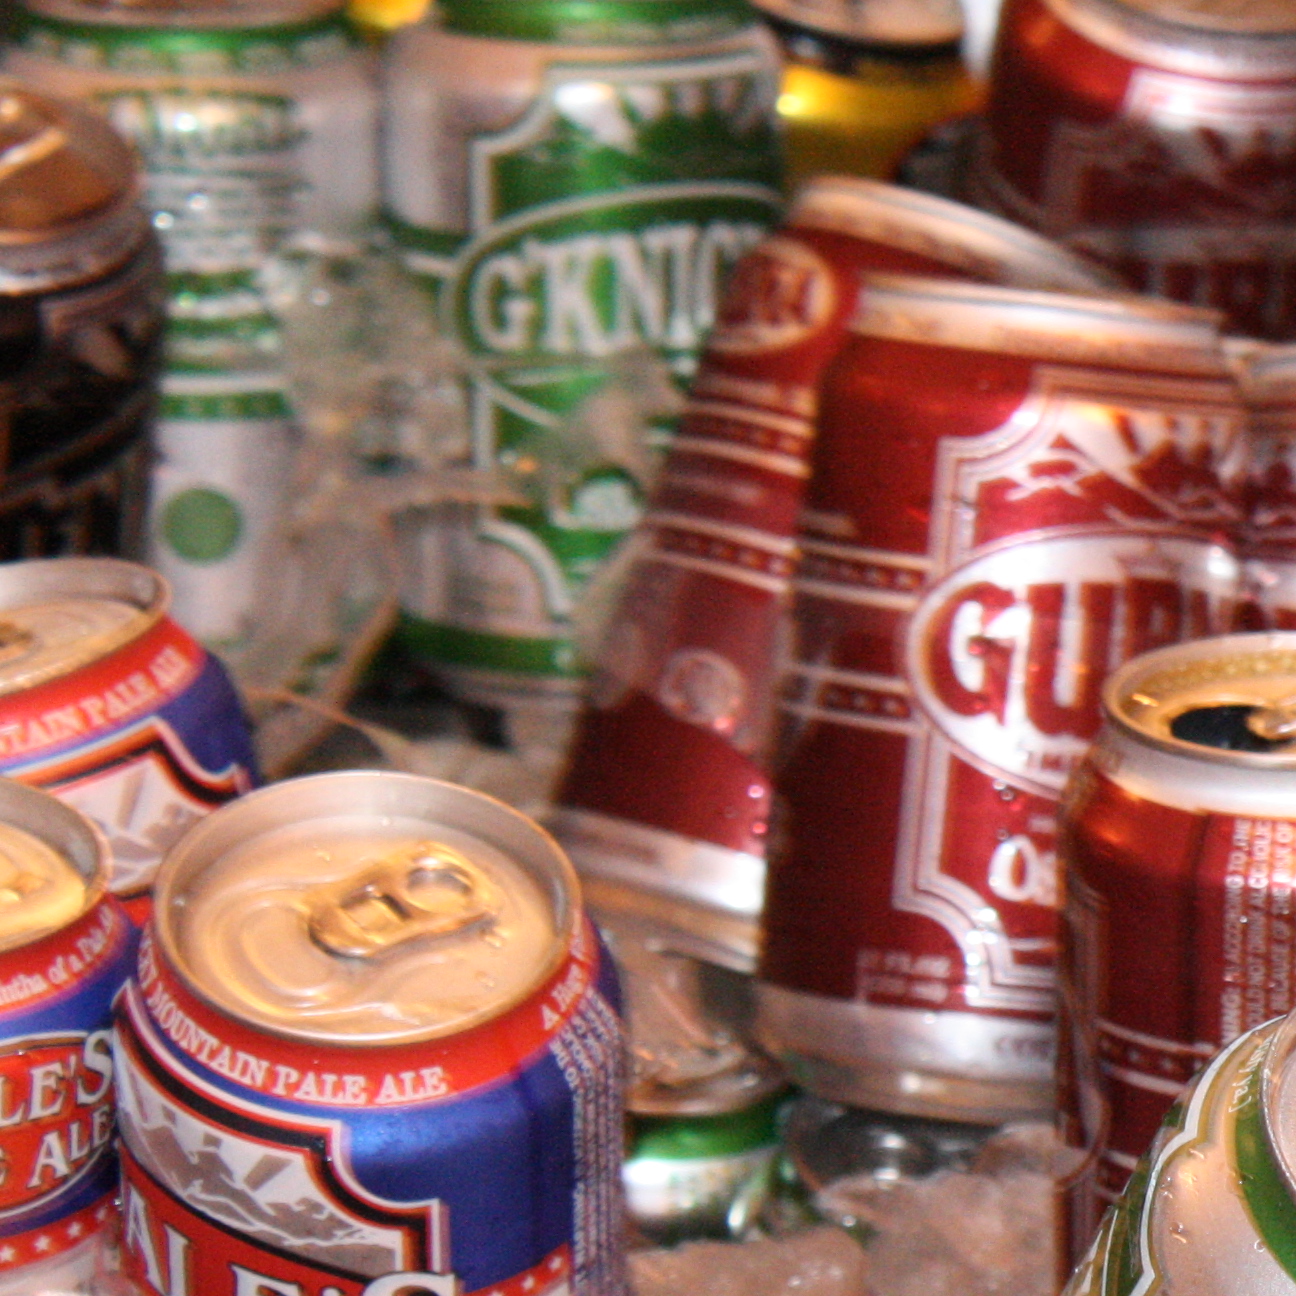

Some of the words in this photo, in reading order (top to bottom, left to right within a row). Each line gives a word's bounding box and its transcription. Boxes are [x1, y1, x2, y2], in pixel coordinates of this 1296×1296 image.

[0, 1028, 114, 1126] LE'S
[146, 984, 268, 1082] MOUNTAIN
[273, 1064, 368, 1104] PALE
[378, 1066, 449, 1104] ALE
[27, 1104, 111, 1189] ALE
